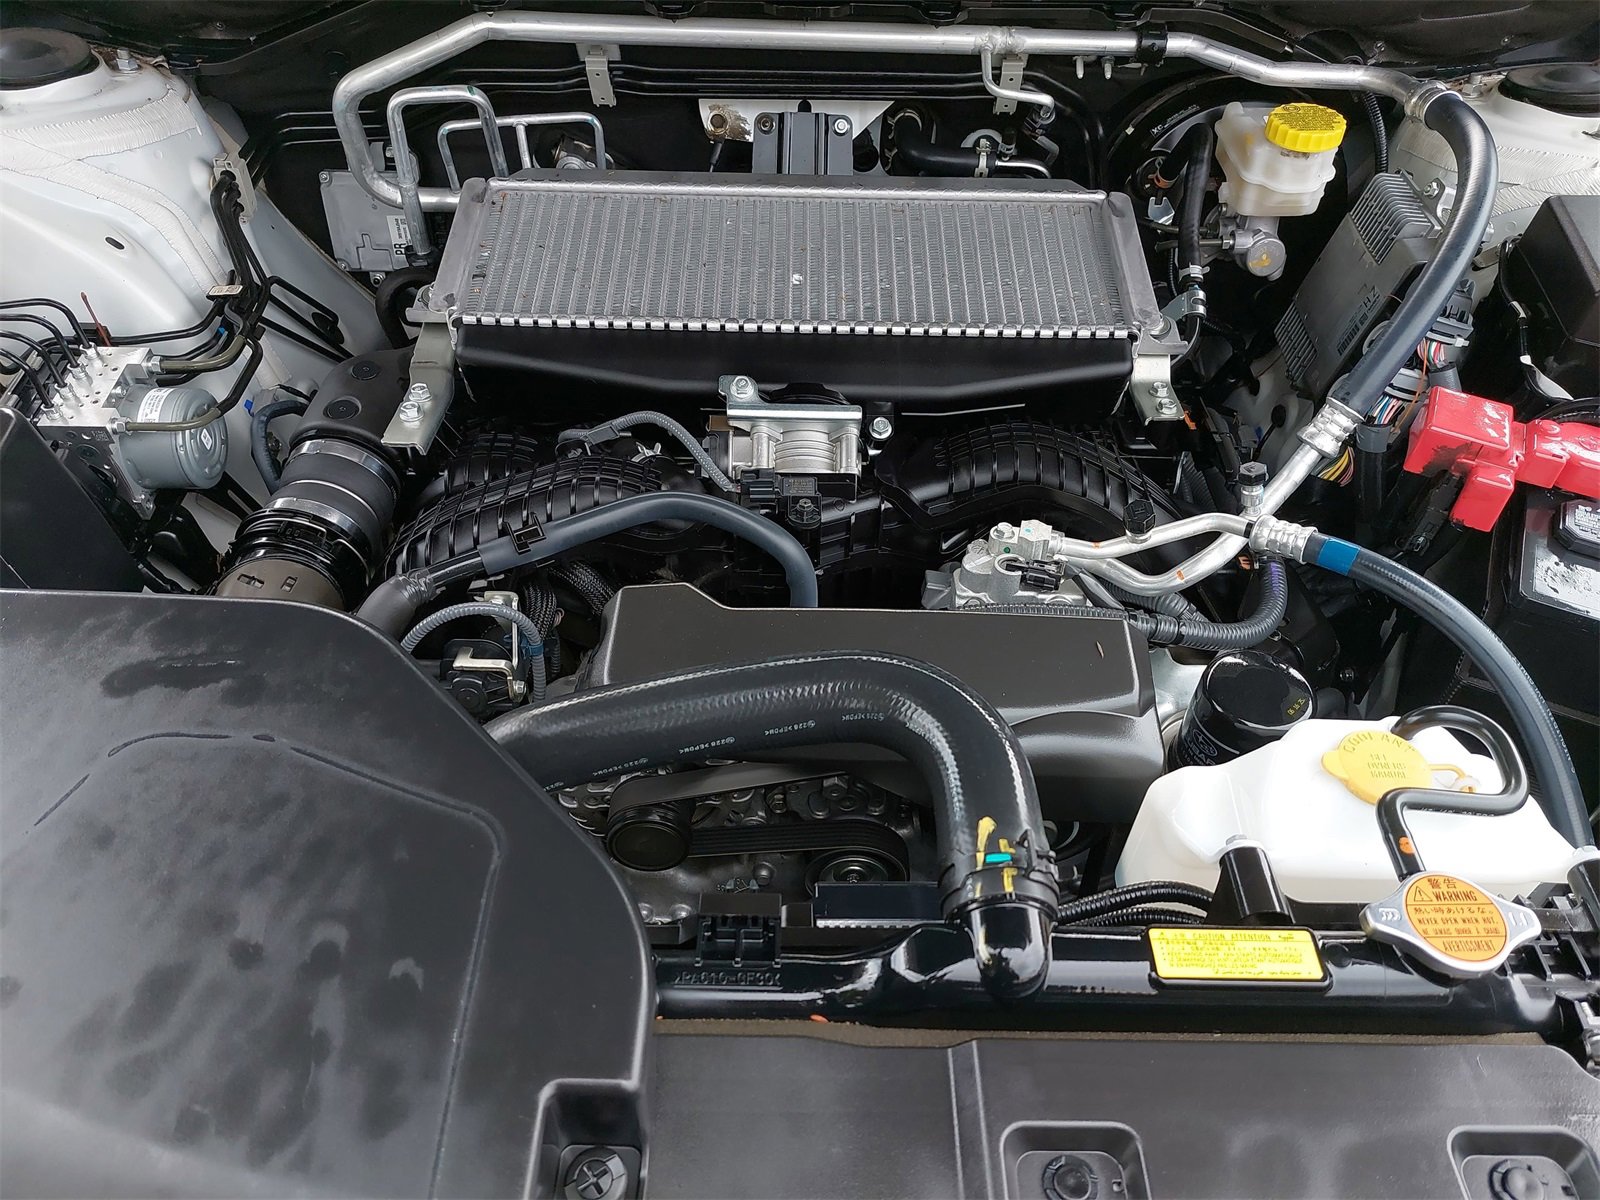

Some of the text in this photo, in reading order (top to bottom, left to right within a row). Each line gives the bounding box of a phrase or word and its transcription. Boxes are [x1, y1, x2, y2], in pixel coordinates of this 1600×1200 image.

[1427, 878, 1457, 889] 警告
[1432, 890, 1478, 902] WARNING
[1417, 917, 1438, 925] NEVER
[1441, 917, 1459, 925] OPEN
[1461, 917, 1479, 925] WHEN
